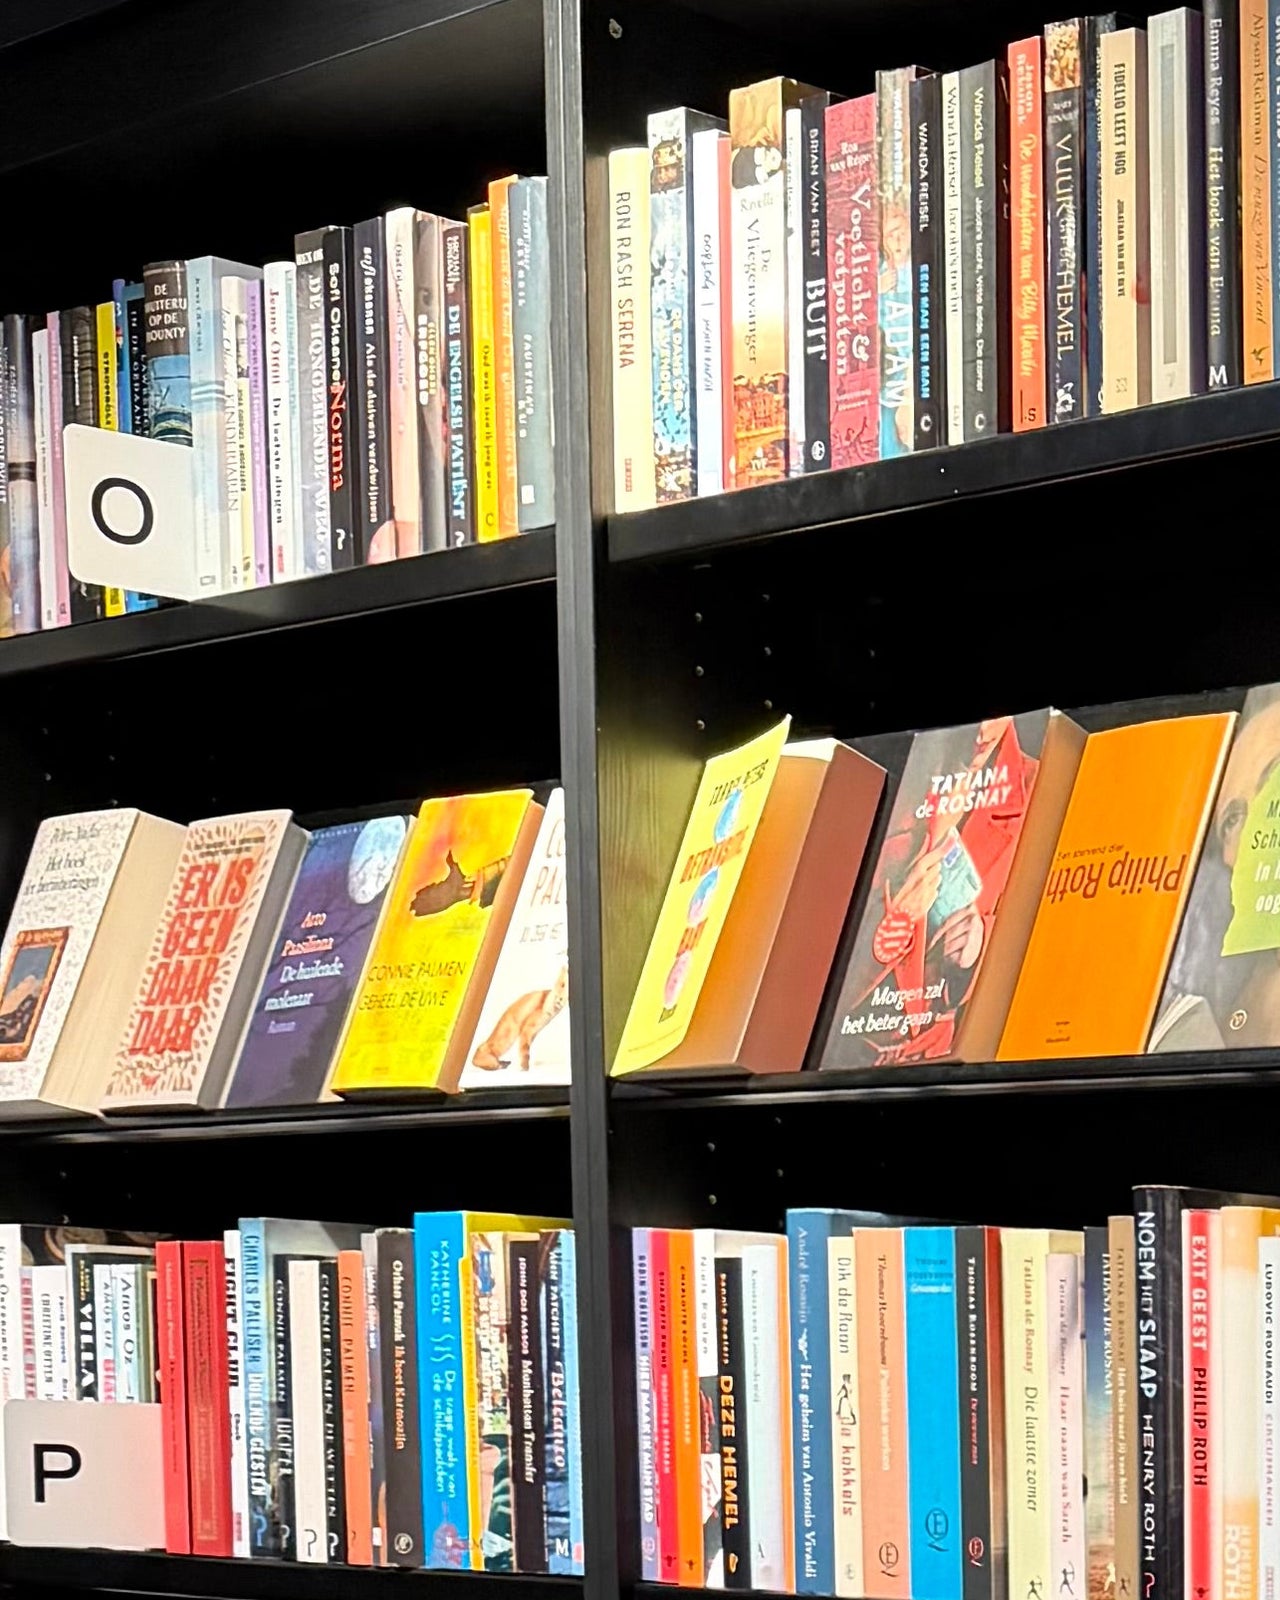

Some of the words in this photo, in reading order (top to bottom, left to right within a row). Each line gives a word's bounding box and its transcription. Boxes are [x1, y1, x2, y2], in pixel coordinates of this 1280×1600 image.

[615, 191, 632, 227] RON
[616, 233, 633, 289] RASH
[617, 298, 635, 369] SERENA
[91, 476, 154, 545] O
[915, 803, 934, 820] de
[934, 784, 1012, 815] ROSNAY
[930, 765, 1009, 796] TATIANA
[176, 863, 214, 908] ER
[218, 856, 255, 904] IS
[1046, 863, 1102, 904] Roth
[1107, 853, 1187, 895] Philip
[1254, 862, 1271, 881] In
[164, 908, 238, 958] GEEN
[146, 958, 220, 1006] DAAR
[871, 988, 923, 1011] Morgen
[924, 979, 945, 1000] zal
[129, 1008, 200, 1055] DAAR
[841, 1016, 865, 1034] het
[865, 1014, 902, 1034] beter
[901, 1010, 933, 1036] gaan
[1191, 1235, 1207, 1278] EXIT
[1192, 1282, 1206, 1350] GEEST
[720, 1375, 734, 1436] DEZE
[1193, 1368, 1206, 1431] PHILIP
[33, 1444, 82, 1503] P
[1193, 1437, 1207, 1486] ROTH
[722, 1442, 738, 1530] HEMEL
